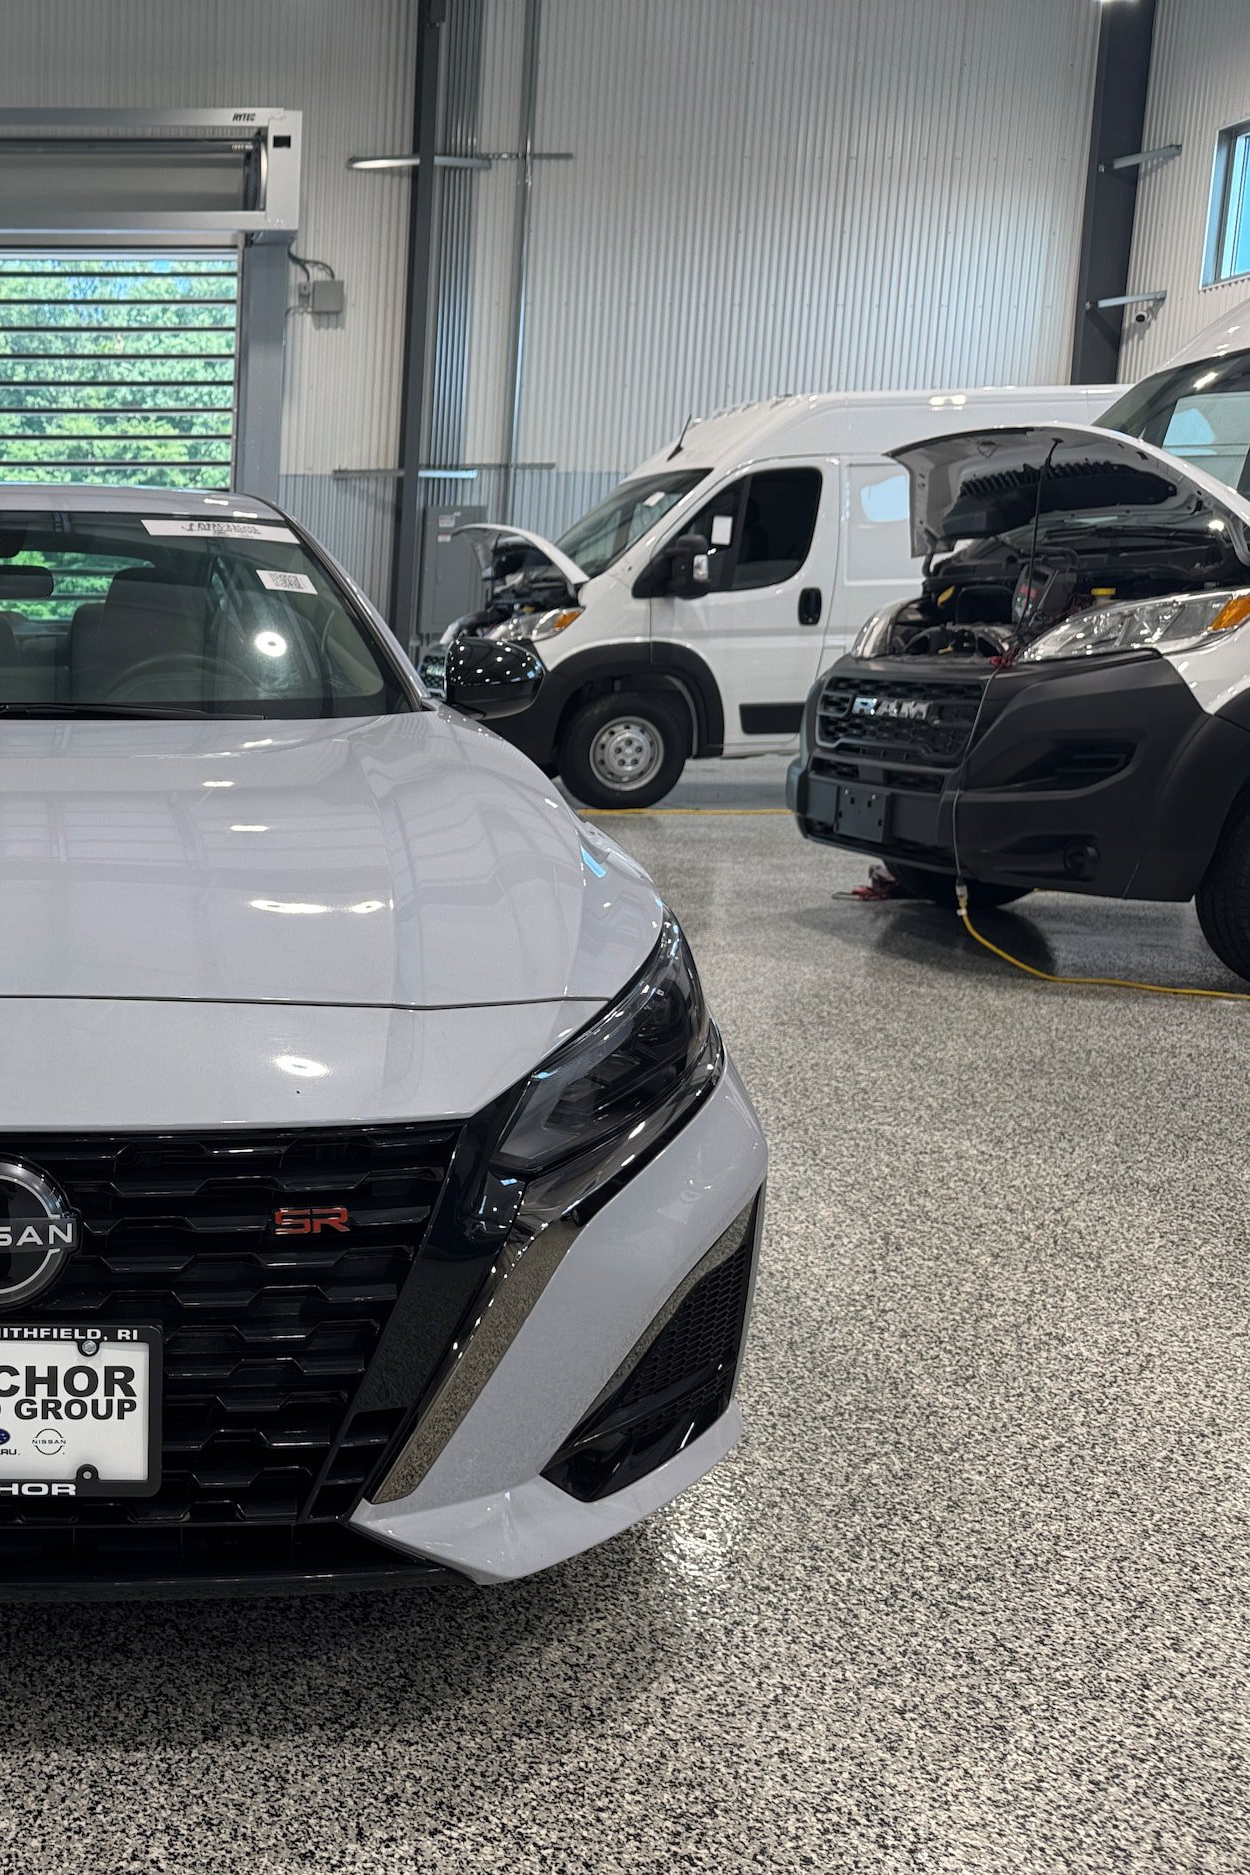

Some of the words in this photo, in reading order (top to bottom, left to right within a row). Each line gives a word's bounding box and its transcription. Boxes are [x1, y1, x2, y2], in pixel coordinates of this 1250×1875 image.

[852, 697, 930, 720] RAM
[274, 1206, 350, 1235] SR
[116, 1328, 139, 1341] RI
[13, 1398, 138, 1421] GROUP
